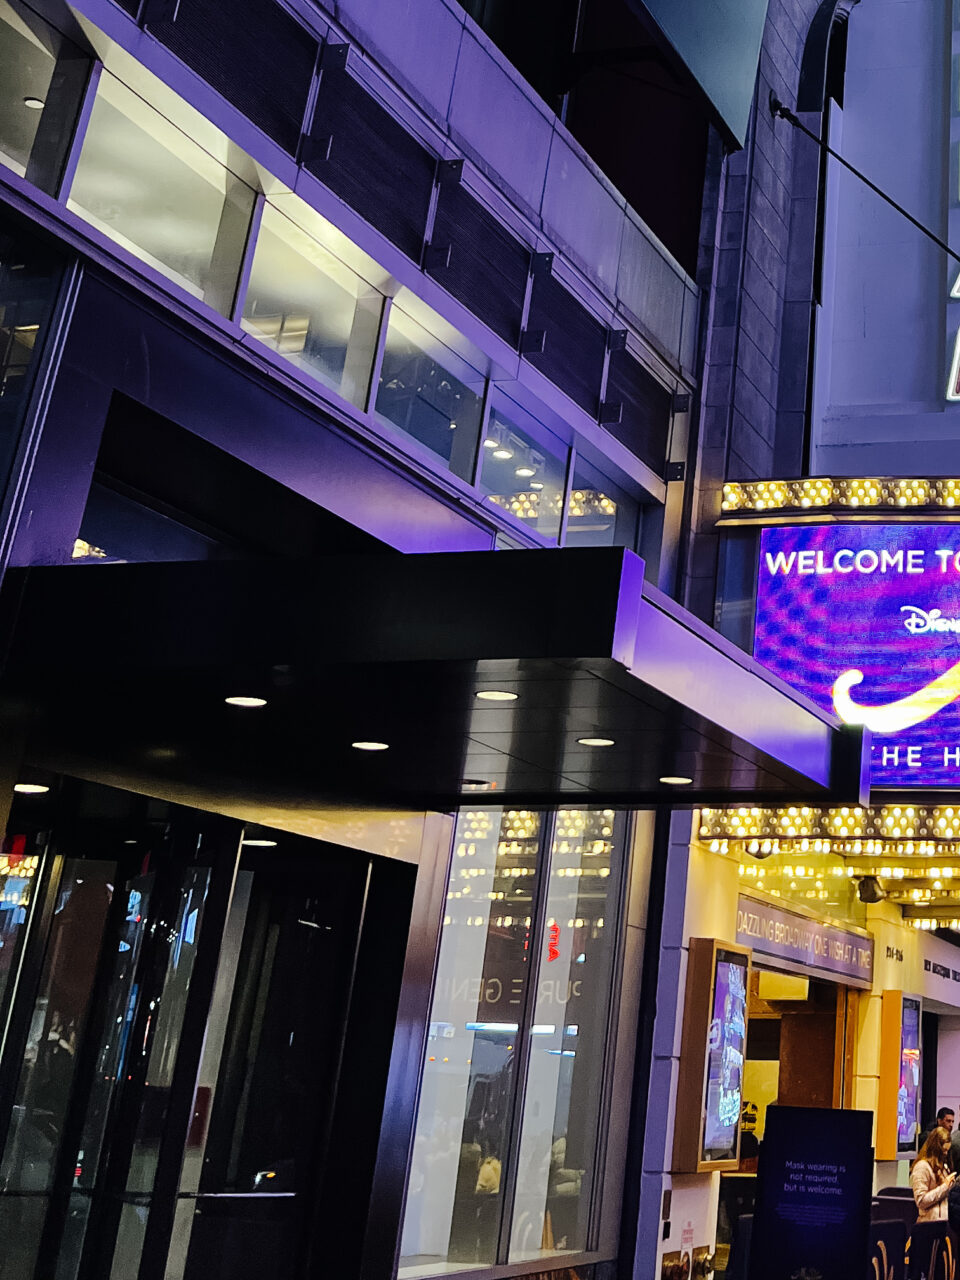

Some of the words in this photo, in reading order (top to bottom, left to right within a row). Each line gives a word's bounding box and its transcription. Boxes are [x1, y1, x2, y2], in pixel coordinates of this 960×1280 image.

[765, 549, 925, 575] WELCOME
[871, 746, 923, 767] HE
[737, 910, 774, 942] DAZZLING
[774, 919, 814, 953] BROADWAY
[814, 934, 828, 957] ONE
[785, 1160, 805, 1170] Mask
[807, 1163, 838, 1174] wearing
[790, 1173, 804, 1181] not
[783, 1183, 798, 1192] but
[799, 1185, 806, 1193] is
